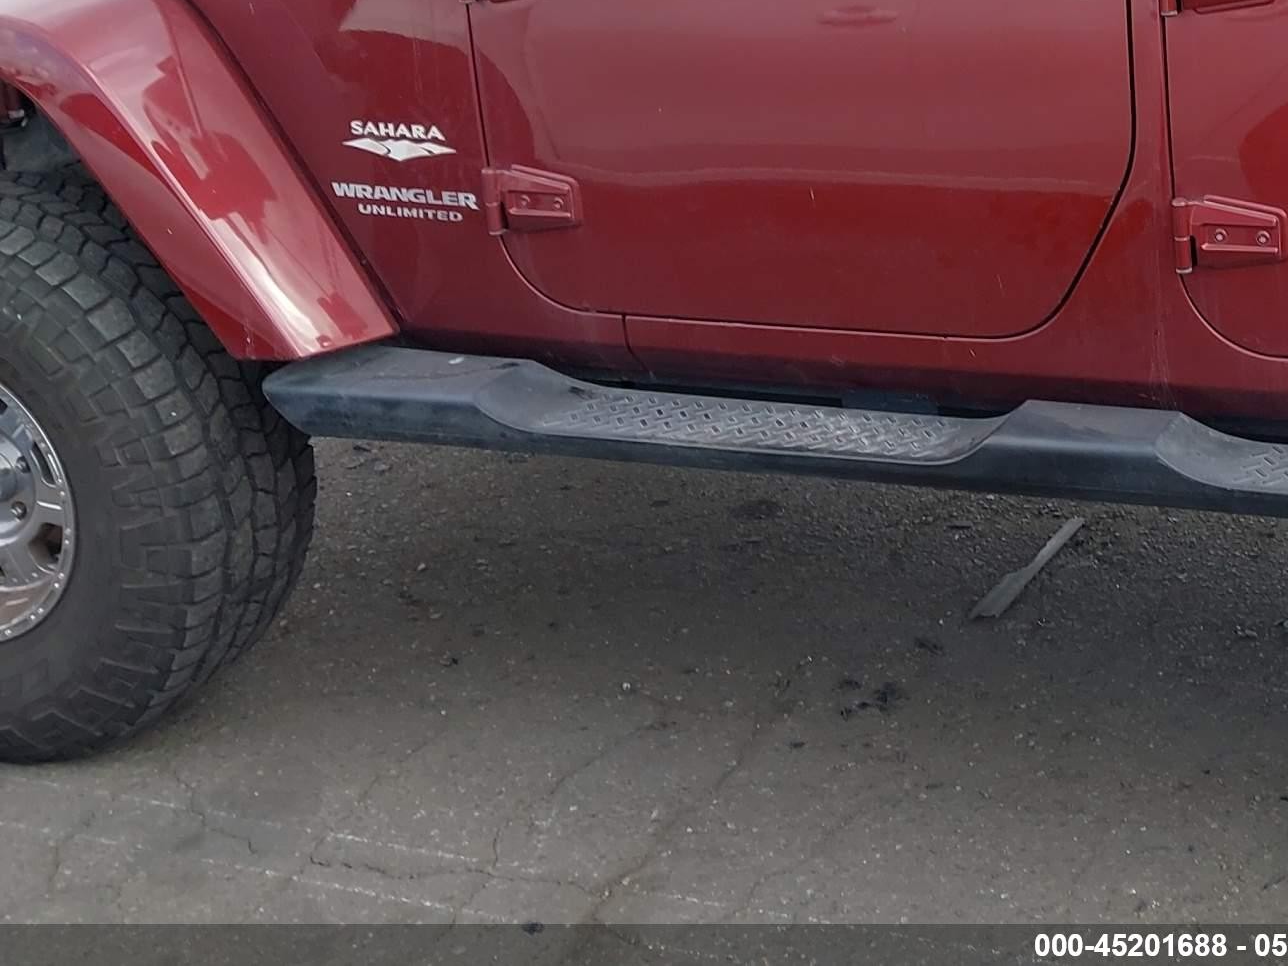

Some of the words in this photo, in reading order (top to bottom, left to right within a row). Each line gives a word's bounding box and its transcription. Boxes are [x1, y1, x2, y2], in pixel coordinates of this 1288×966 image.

[350, 120, 445, 141] SAHARA
[331, 182, 480, 210] WRANGLER
[358, 203, 464, 222] UNLIMITED
